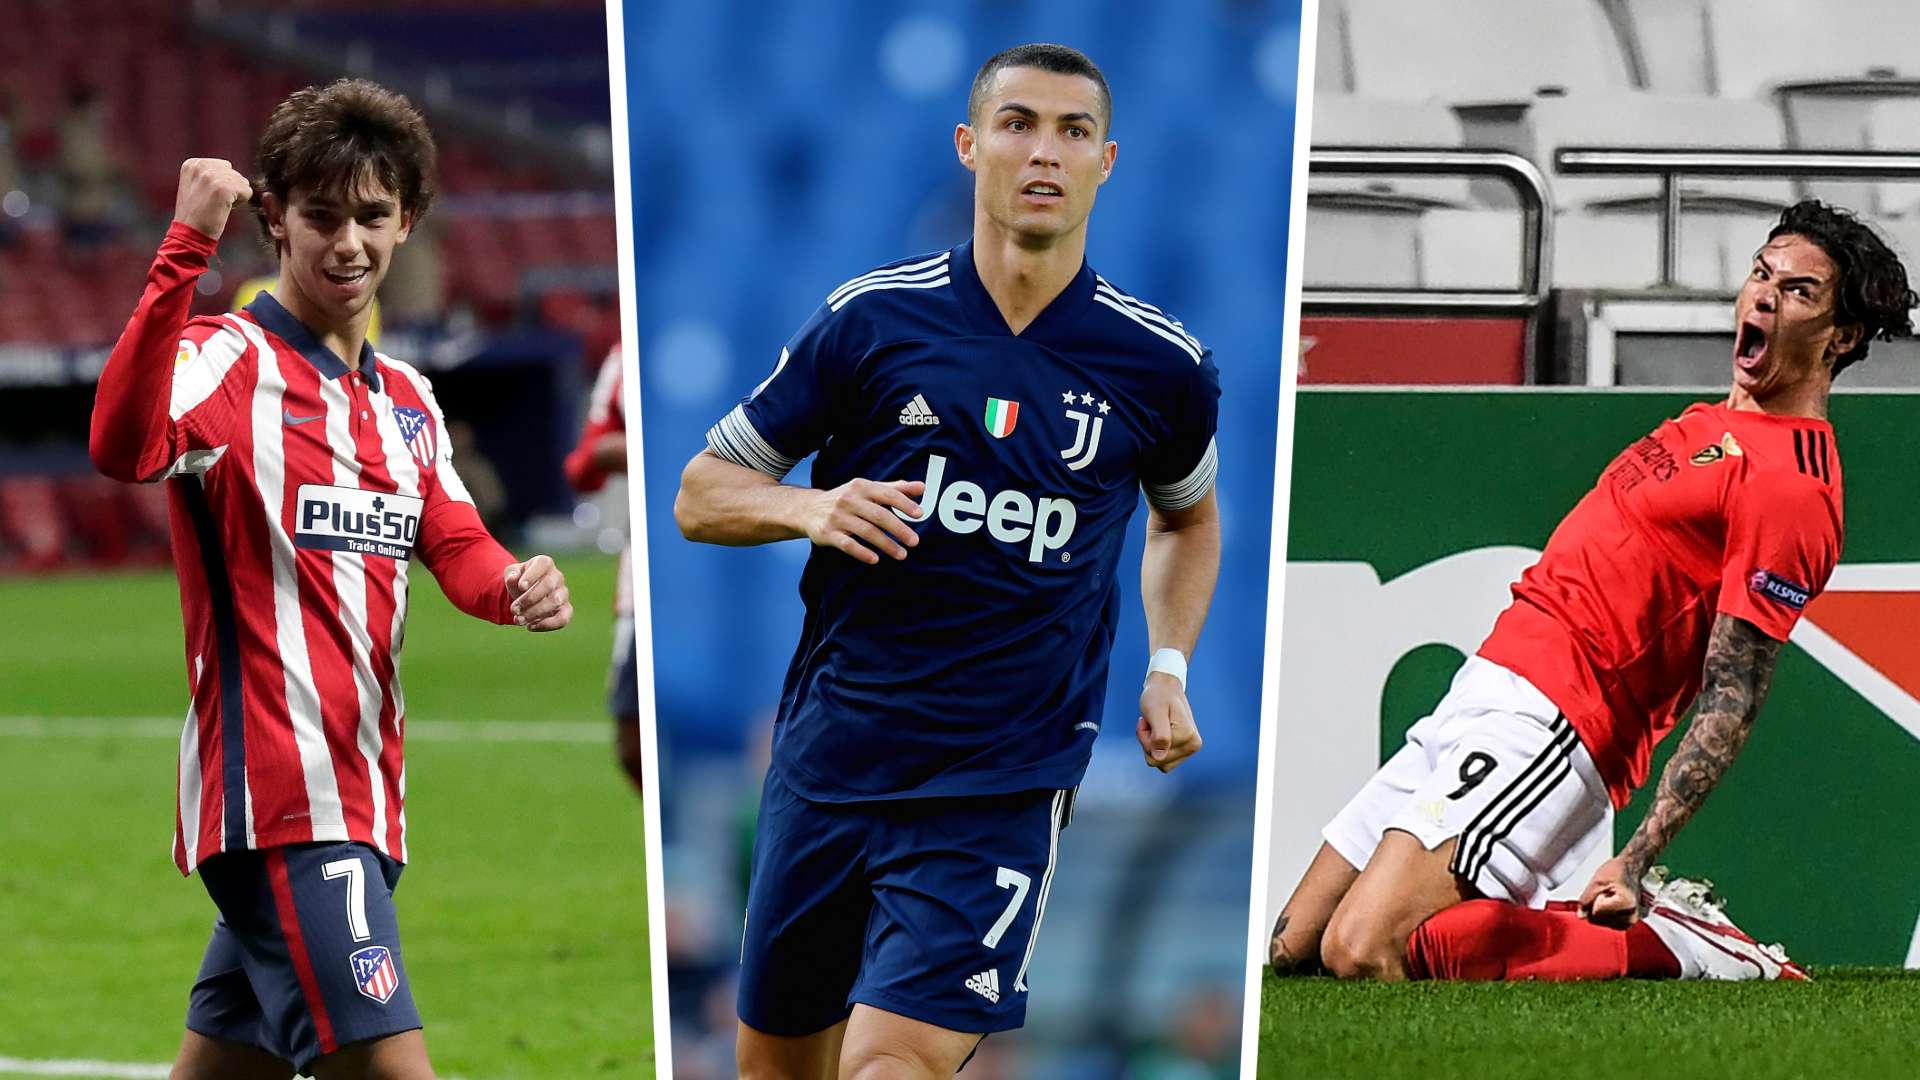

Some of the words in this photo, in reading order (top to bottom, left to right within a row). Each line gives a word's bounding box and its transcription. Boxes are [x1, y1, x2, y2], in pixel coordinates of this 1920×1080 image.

[899, 414, 940, 425] adidas
[891, 454, 1077, 563] Jeep
[347, 539, 376, 553] Trade
[377, 544, 406, 558] Online
[1445, 751, 1498, 801] 9
[321, 857, 371, 943] 7
[982, 866, 1032, 950] 7
